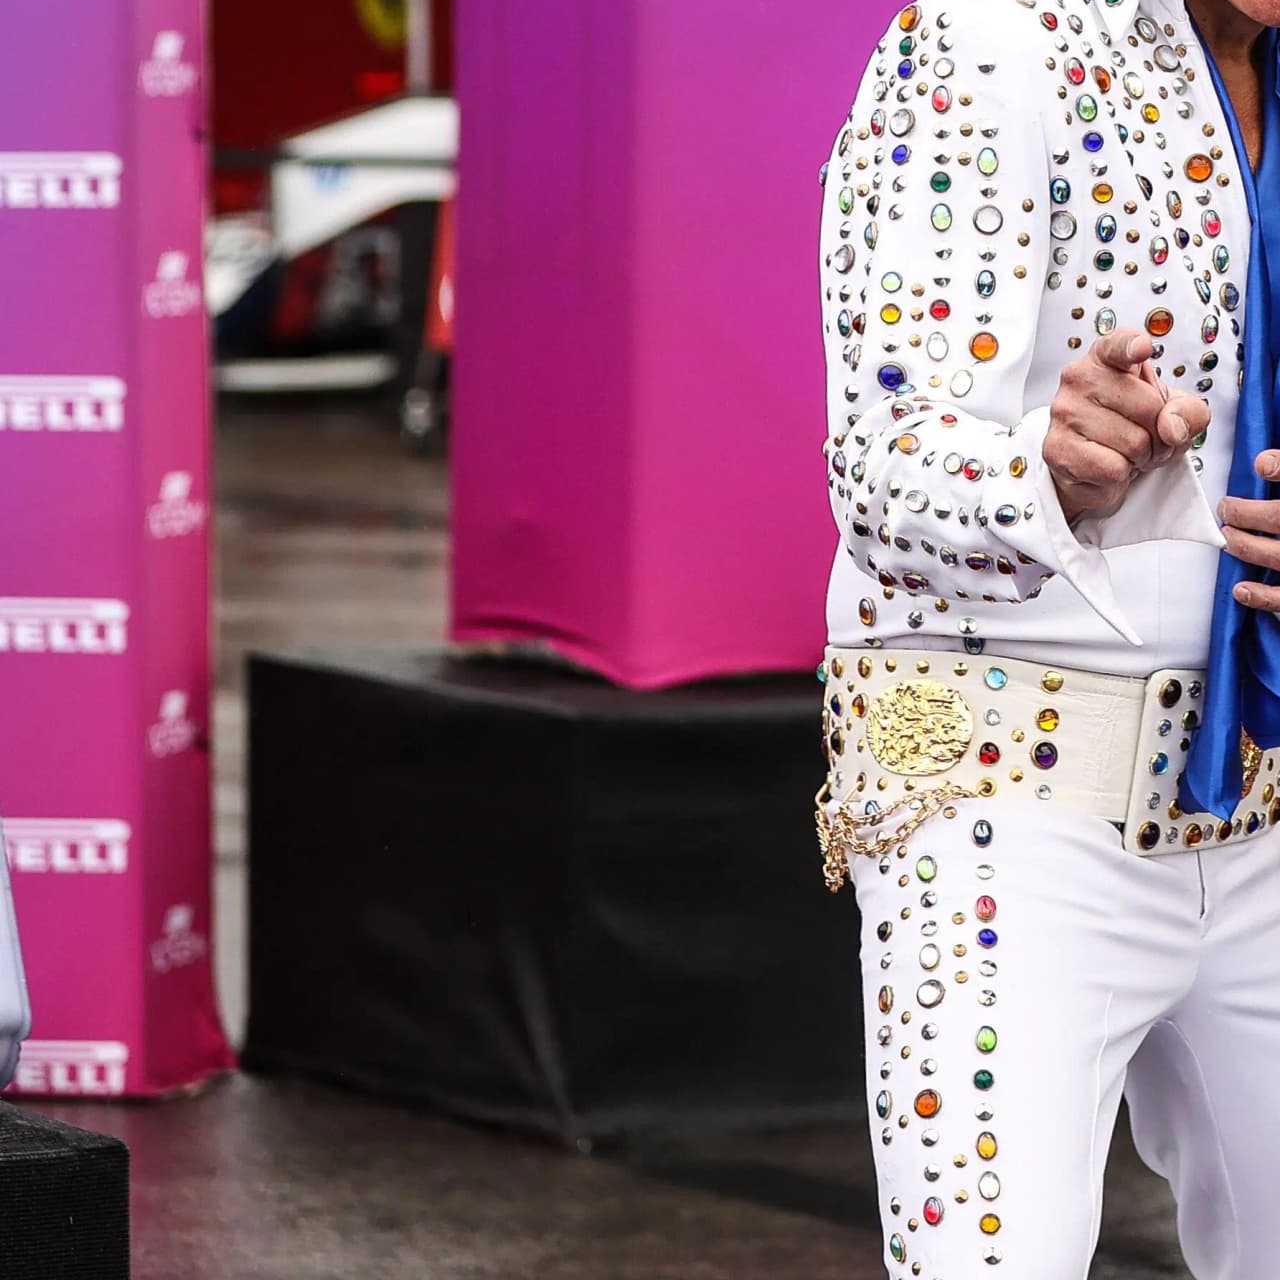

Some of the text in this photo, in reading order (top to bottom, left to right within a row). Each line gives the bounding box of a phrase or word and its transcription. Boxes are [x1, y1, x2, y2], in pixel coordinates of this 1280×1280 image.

[0, 152, 122, 207] ELLI
[0, 375, 126, 431] ELLI
[0, 597, 129, 654] ELLI
[3, 818, 129, 874] ELLI
[16, 1040, 128, 1094] ELLI
